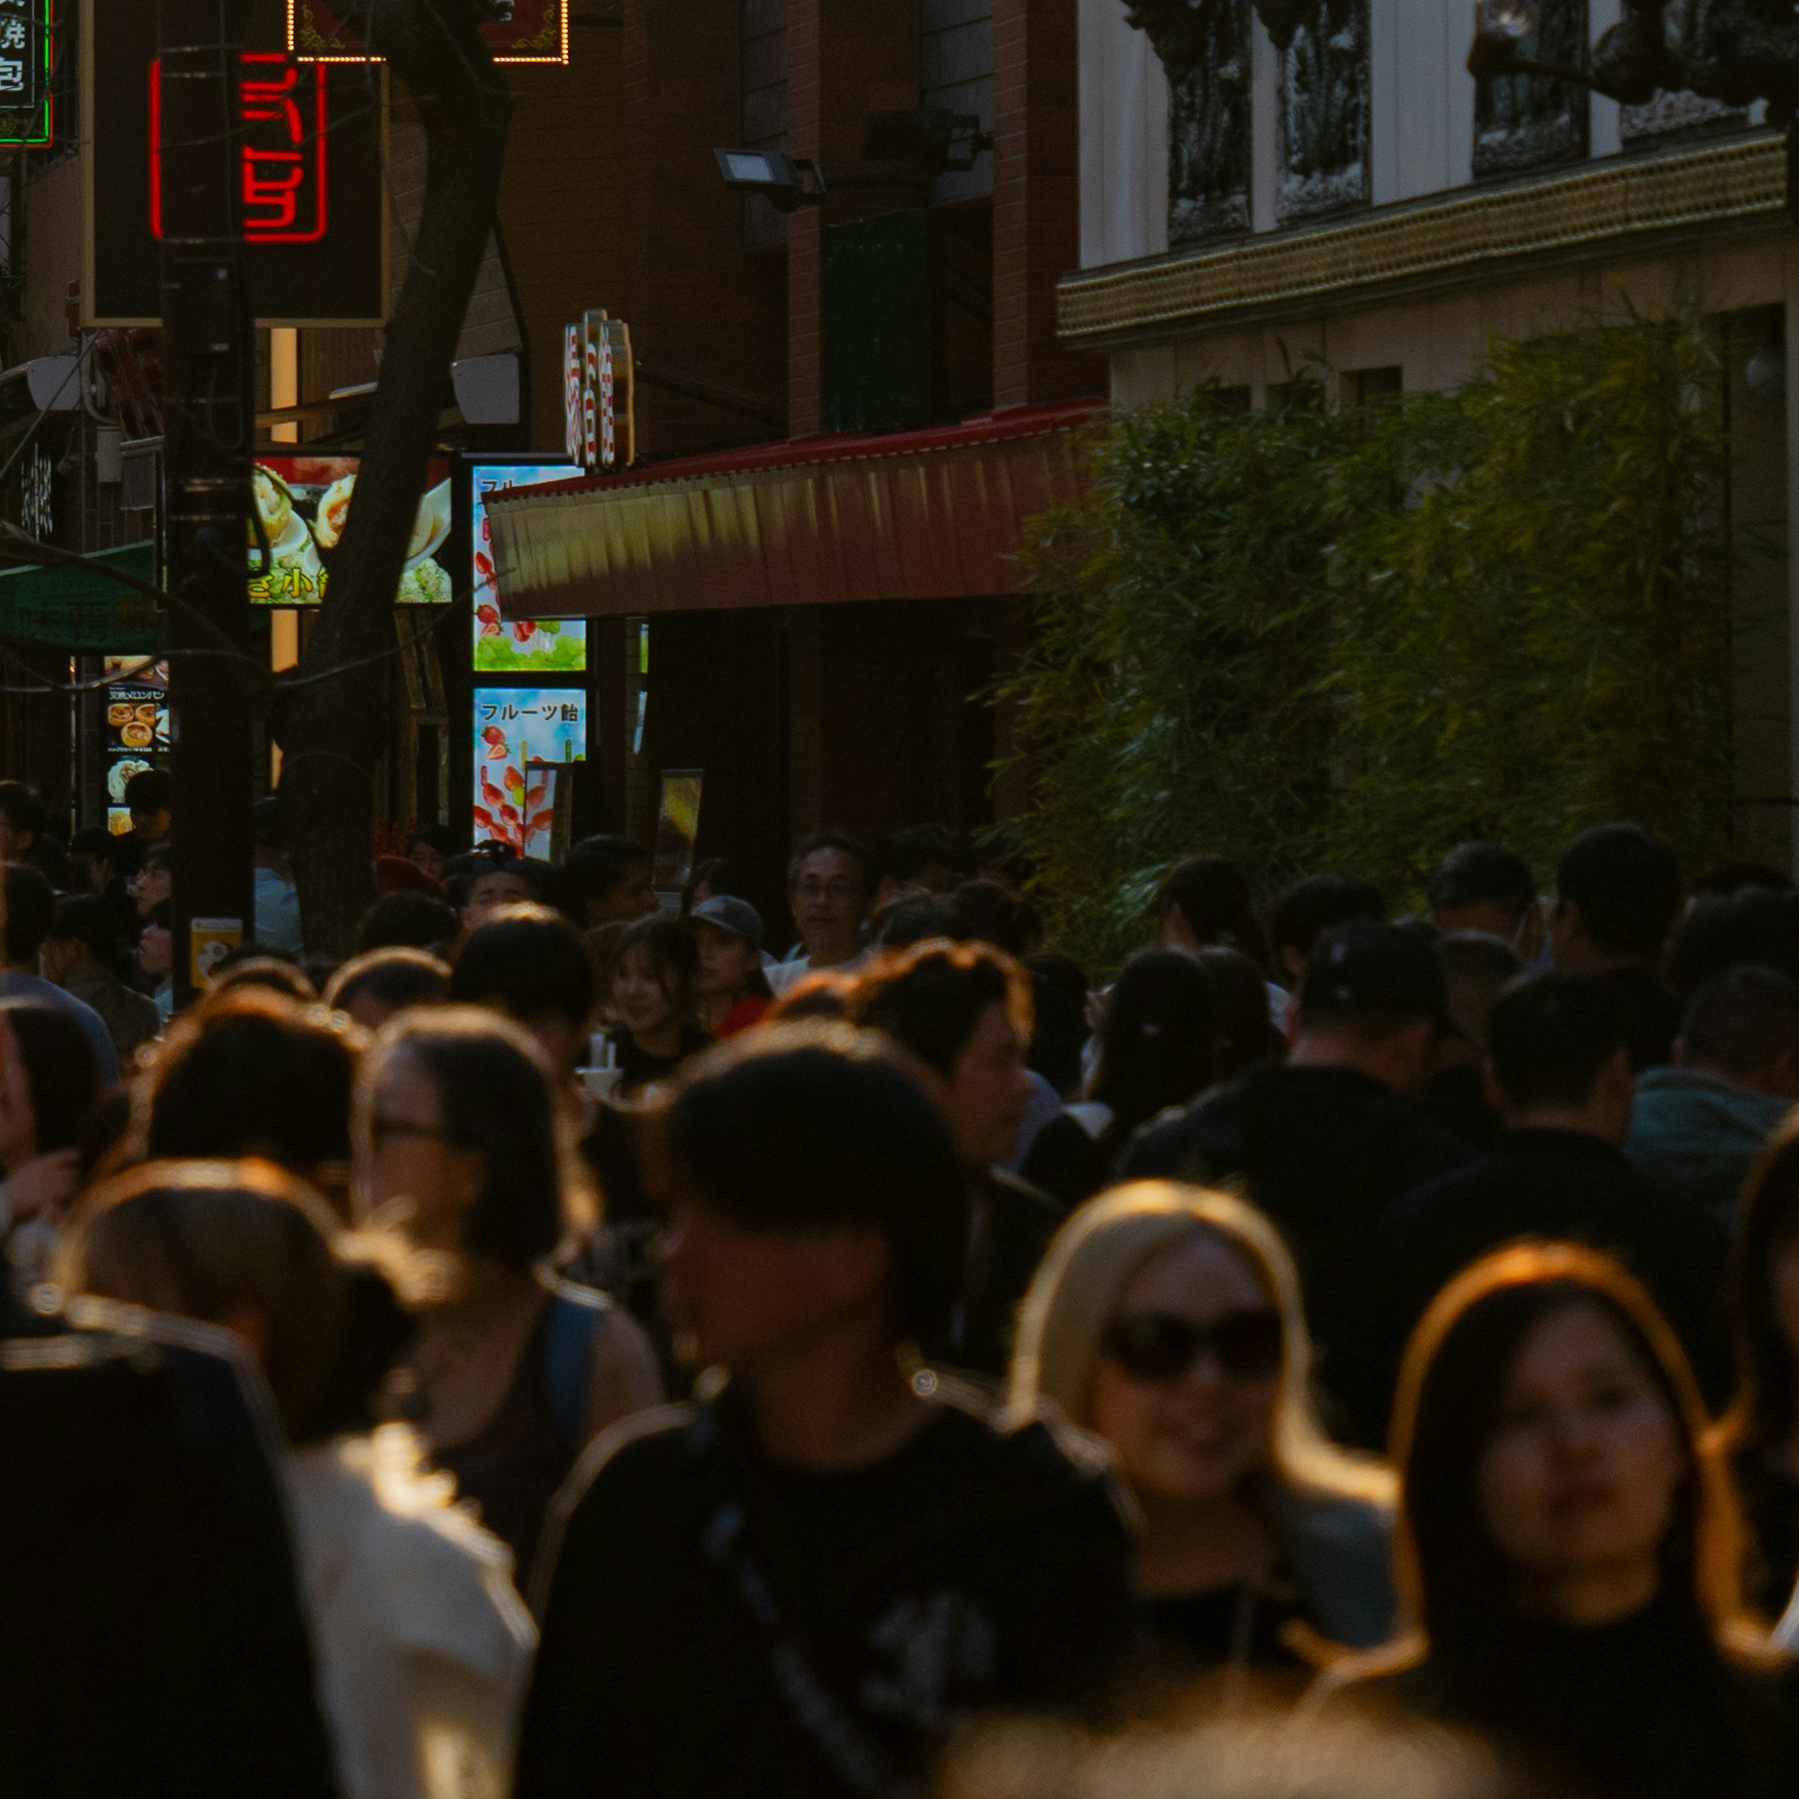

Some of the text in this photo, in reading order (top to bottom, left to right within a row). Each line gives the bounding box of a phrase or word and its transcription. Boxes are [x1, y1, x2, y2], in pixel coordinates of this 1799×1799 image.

[481, 704, 579, 723] フルーツ飴
